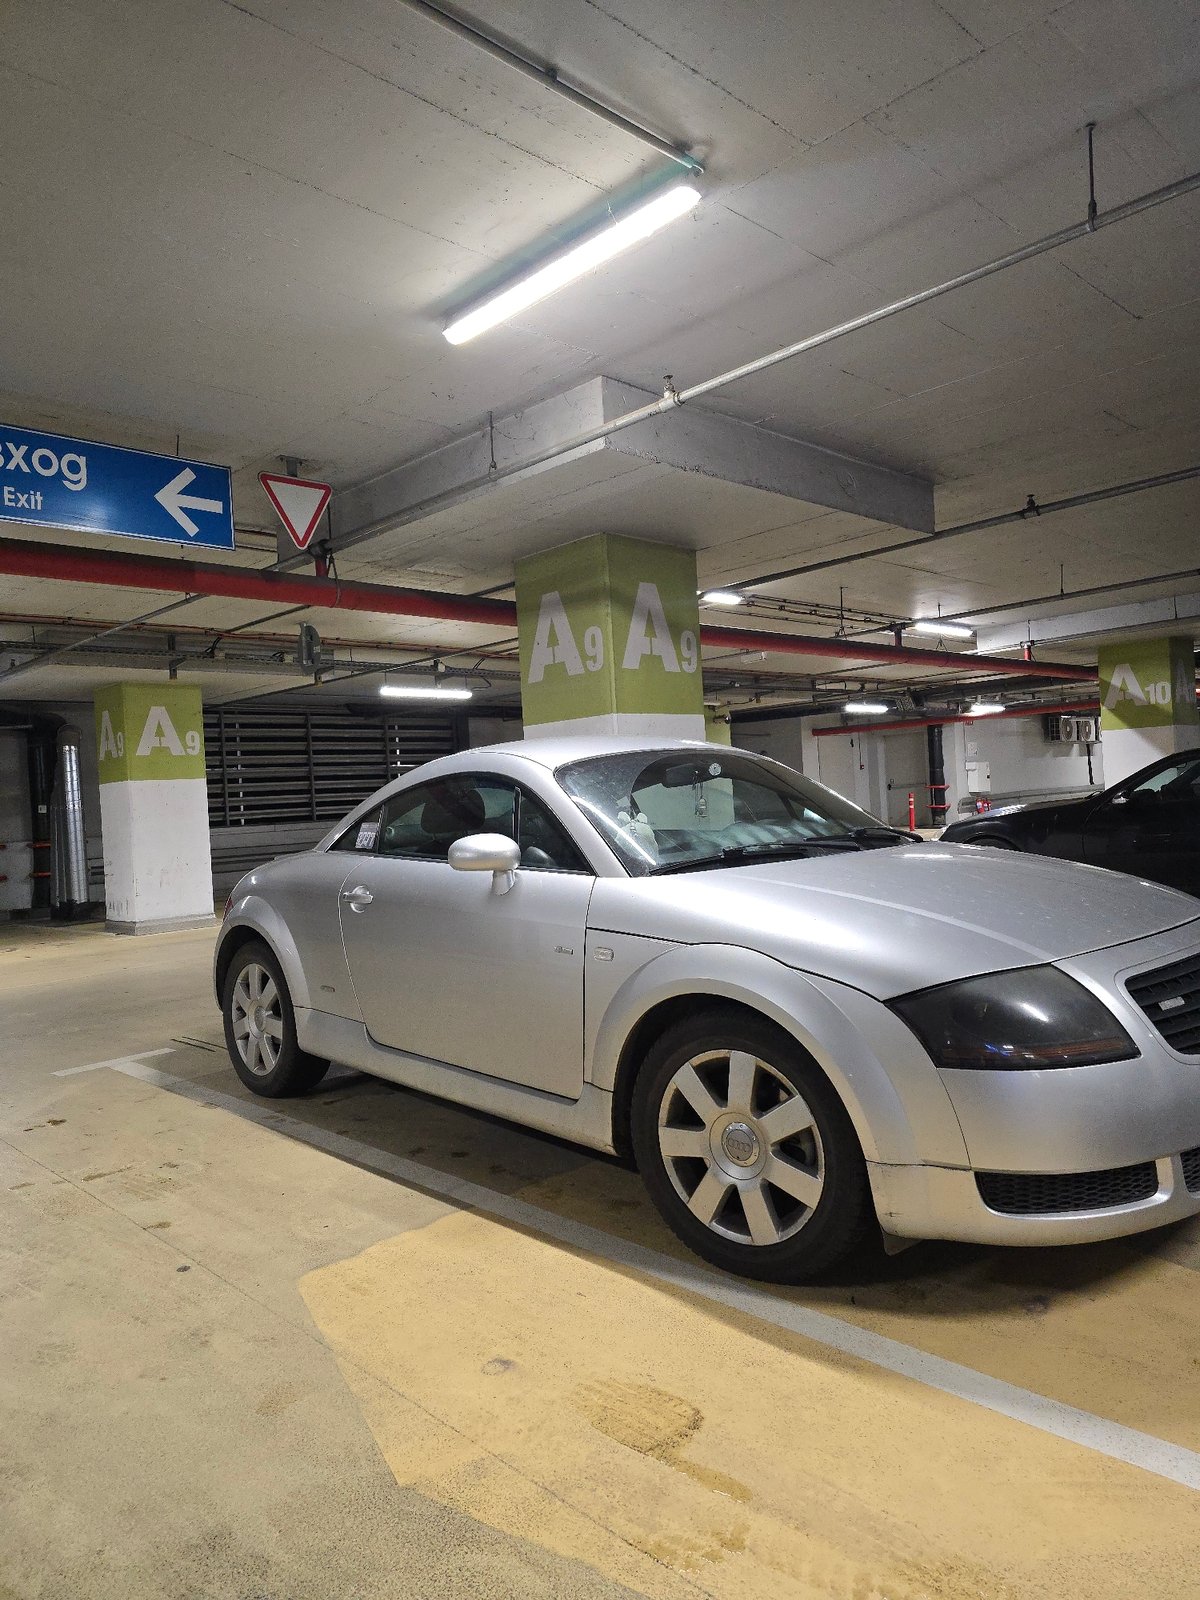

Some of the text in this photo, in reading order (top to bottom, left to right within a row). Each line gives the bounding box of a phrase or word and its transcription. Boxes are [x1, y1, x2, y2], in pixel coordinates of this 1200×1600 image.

[3, 485, 43, 511] Exit
[528, 590, 604, 684] A9
[622, 581, 698, 674] A9
[1103, 663, 1172, 710] A10
[99, 710, 124, 761] A9
[136, 705, 201, 756] A9
